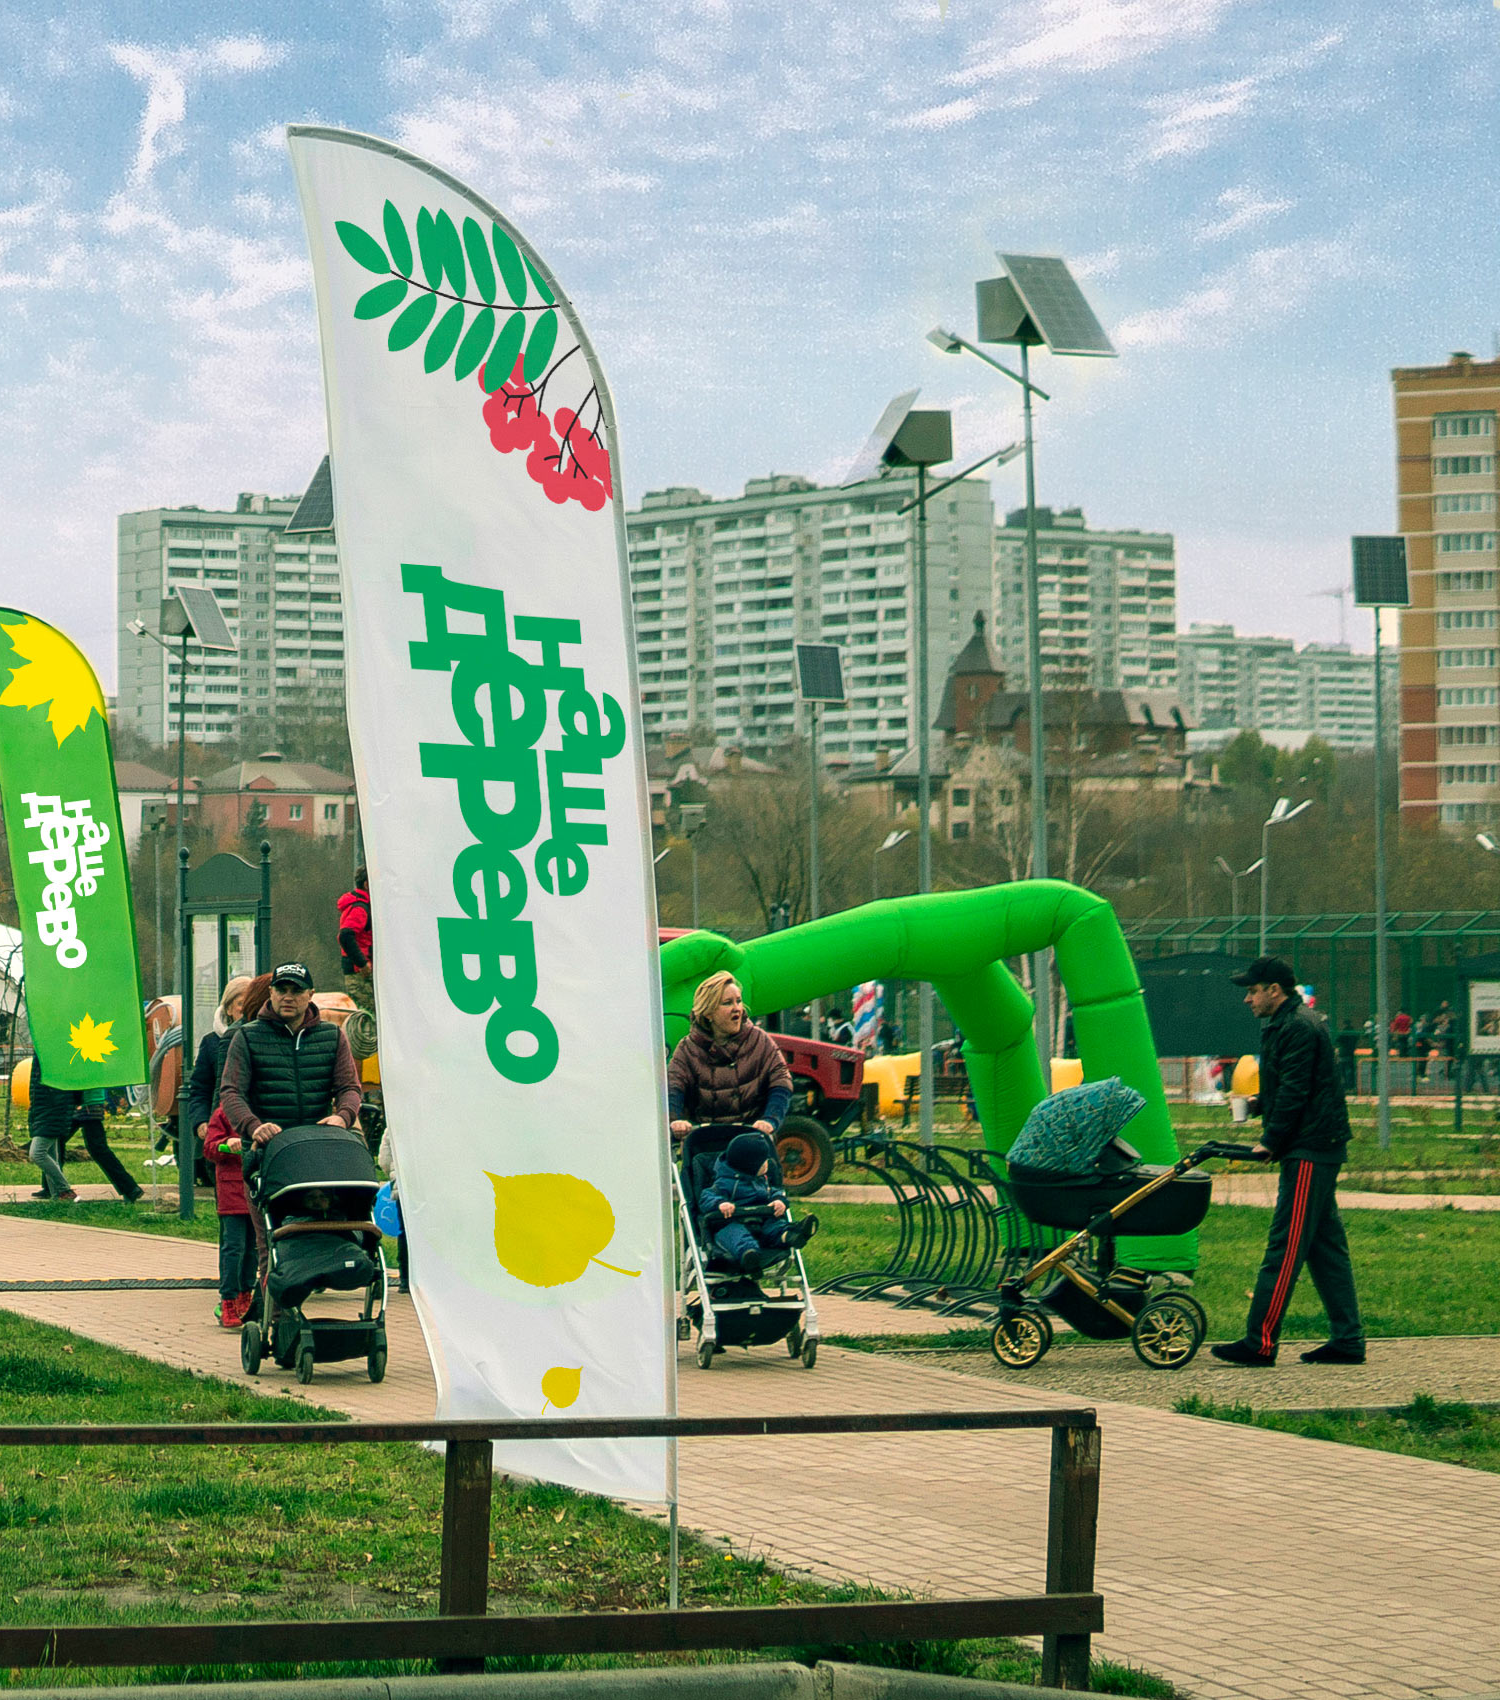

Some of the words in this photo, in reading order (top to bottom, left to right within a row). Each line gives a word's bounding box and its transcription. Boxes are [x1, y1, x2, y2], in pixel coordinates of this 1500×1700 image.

[63, 799, 111, 897] наше
[400, 563, 560, 1085] дерево
[515, 615, 626, 896] наше
[20, 792, 88, 969] дерево
